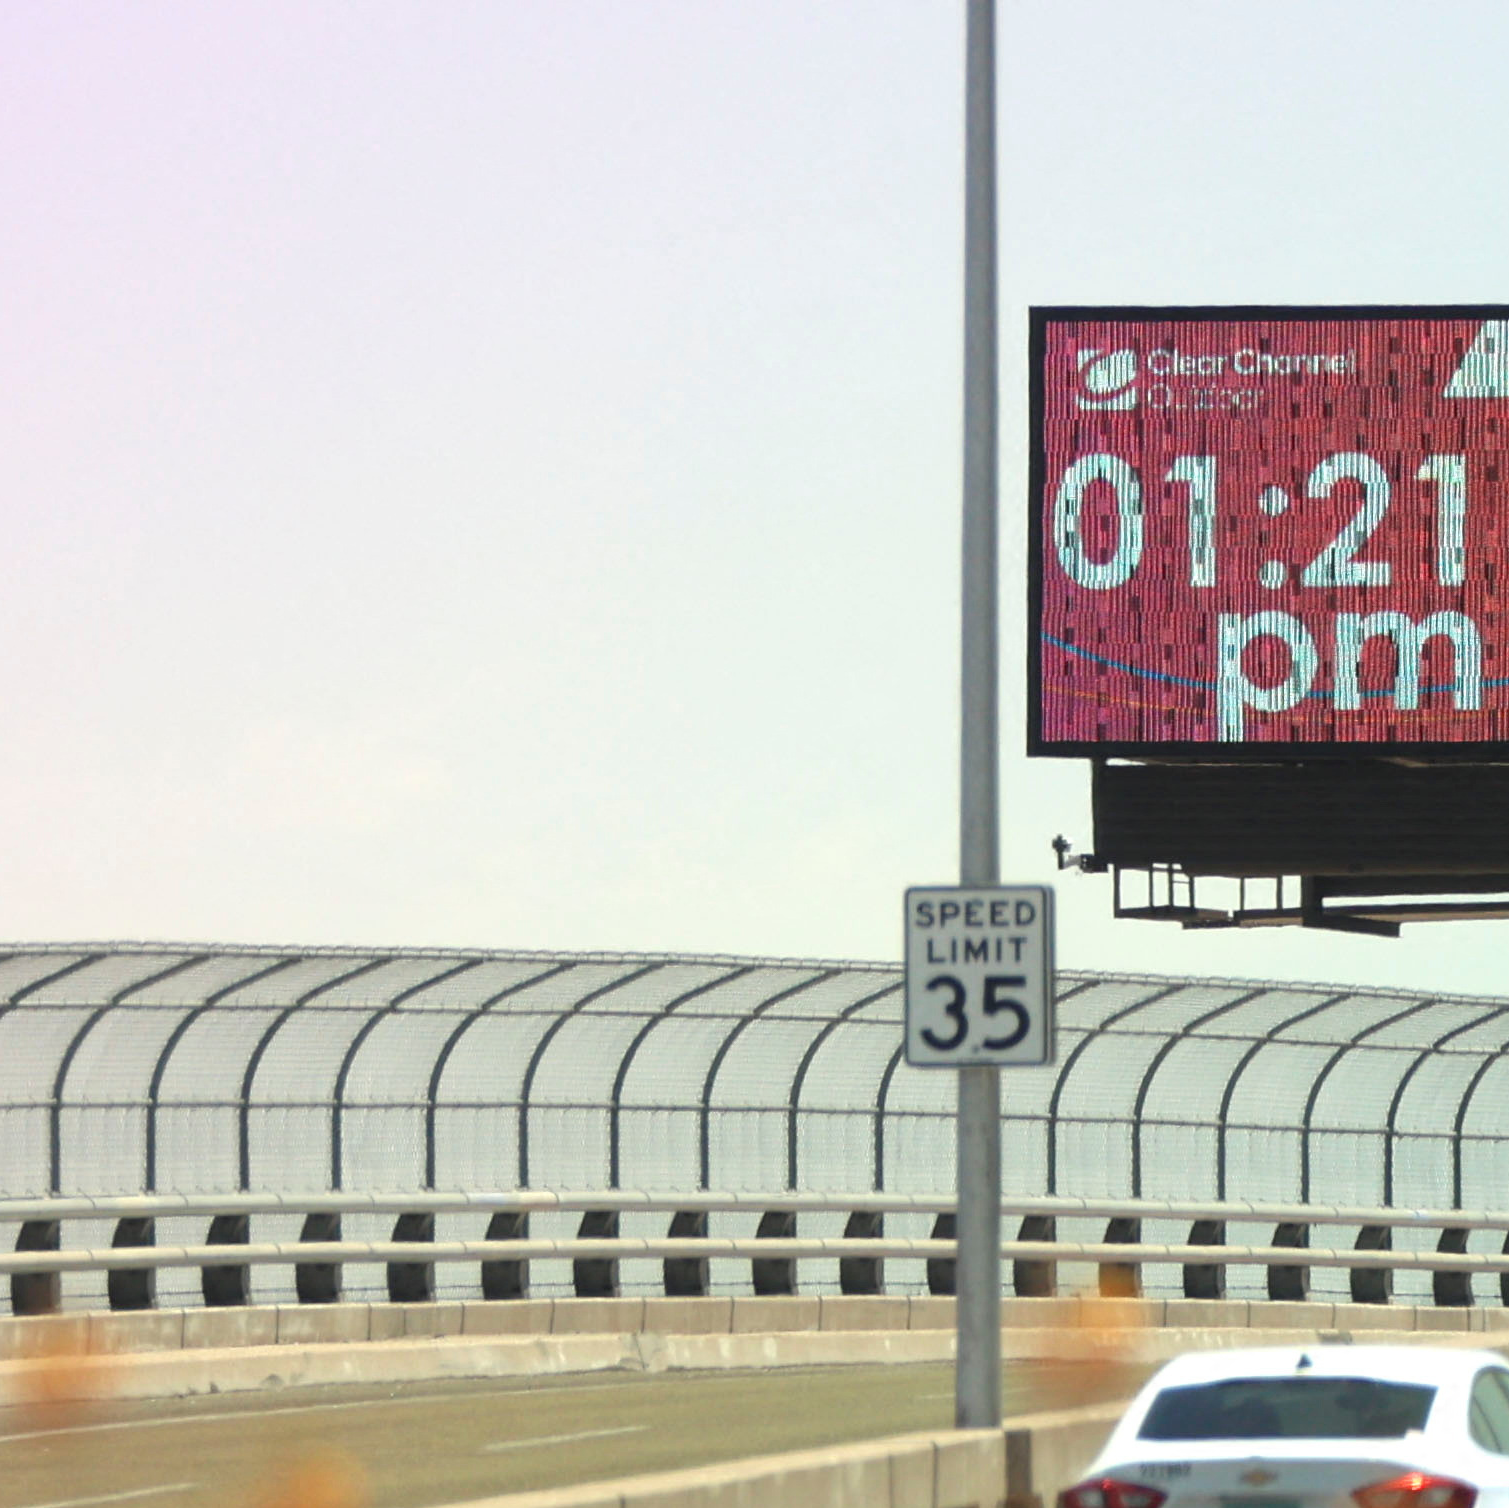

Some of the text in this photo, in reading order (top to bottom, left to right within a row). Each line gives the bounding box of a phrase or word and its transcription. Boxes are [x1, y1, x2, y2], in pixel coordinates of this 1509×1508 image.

[1147, 347, 1357, 377] Clear Channel
[1053, 451, 1467, 590] 01:21
[1216, 610, 1482, 742] pm
[915, 900, 1037, 928] SPEED
[926, 936, 1028, 964] LIMIT
[920, 974, 1031, 1052] 35
